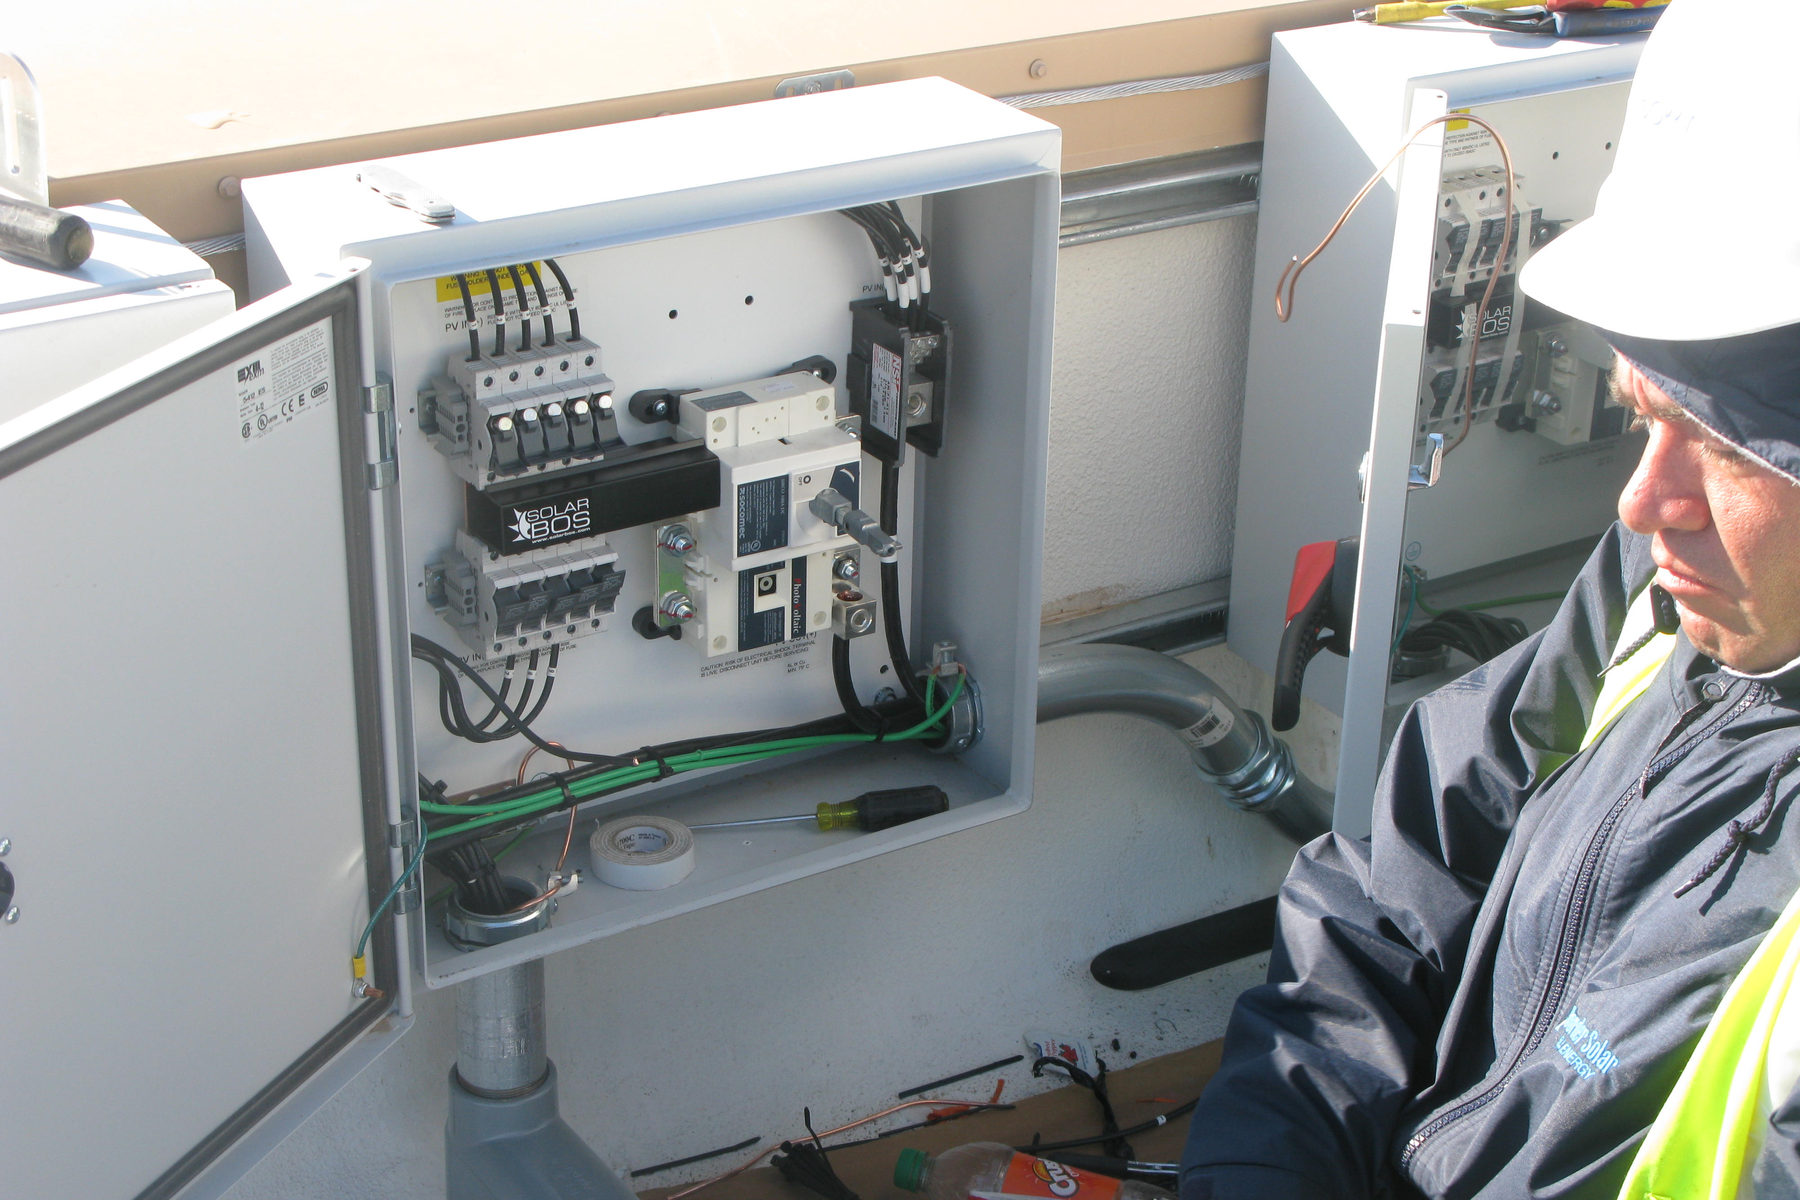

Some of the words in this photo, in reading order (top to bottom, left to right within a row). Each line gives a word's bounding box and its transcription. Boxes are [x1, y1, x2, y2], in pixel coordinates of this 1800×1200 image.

[445, 321, 458, 332] PV
[527, 498, 590, 522] SOLAR
[530, 510, 590, 540] BOS
[532, 527, 590, 544] www.solarbos.com
[792, 578, 802, 634] PhotoVoltaic
[1580, 1030, 1619, 1074] Solar
